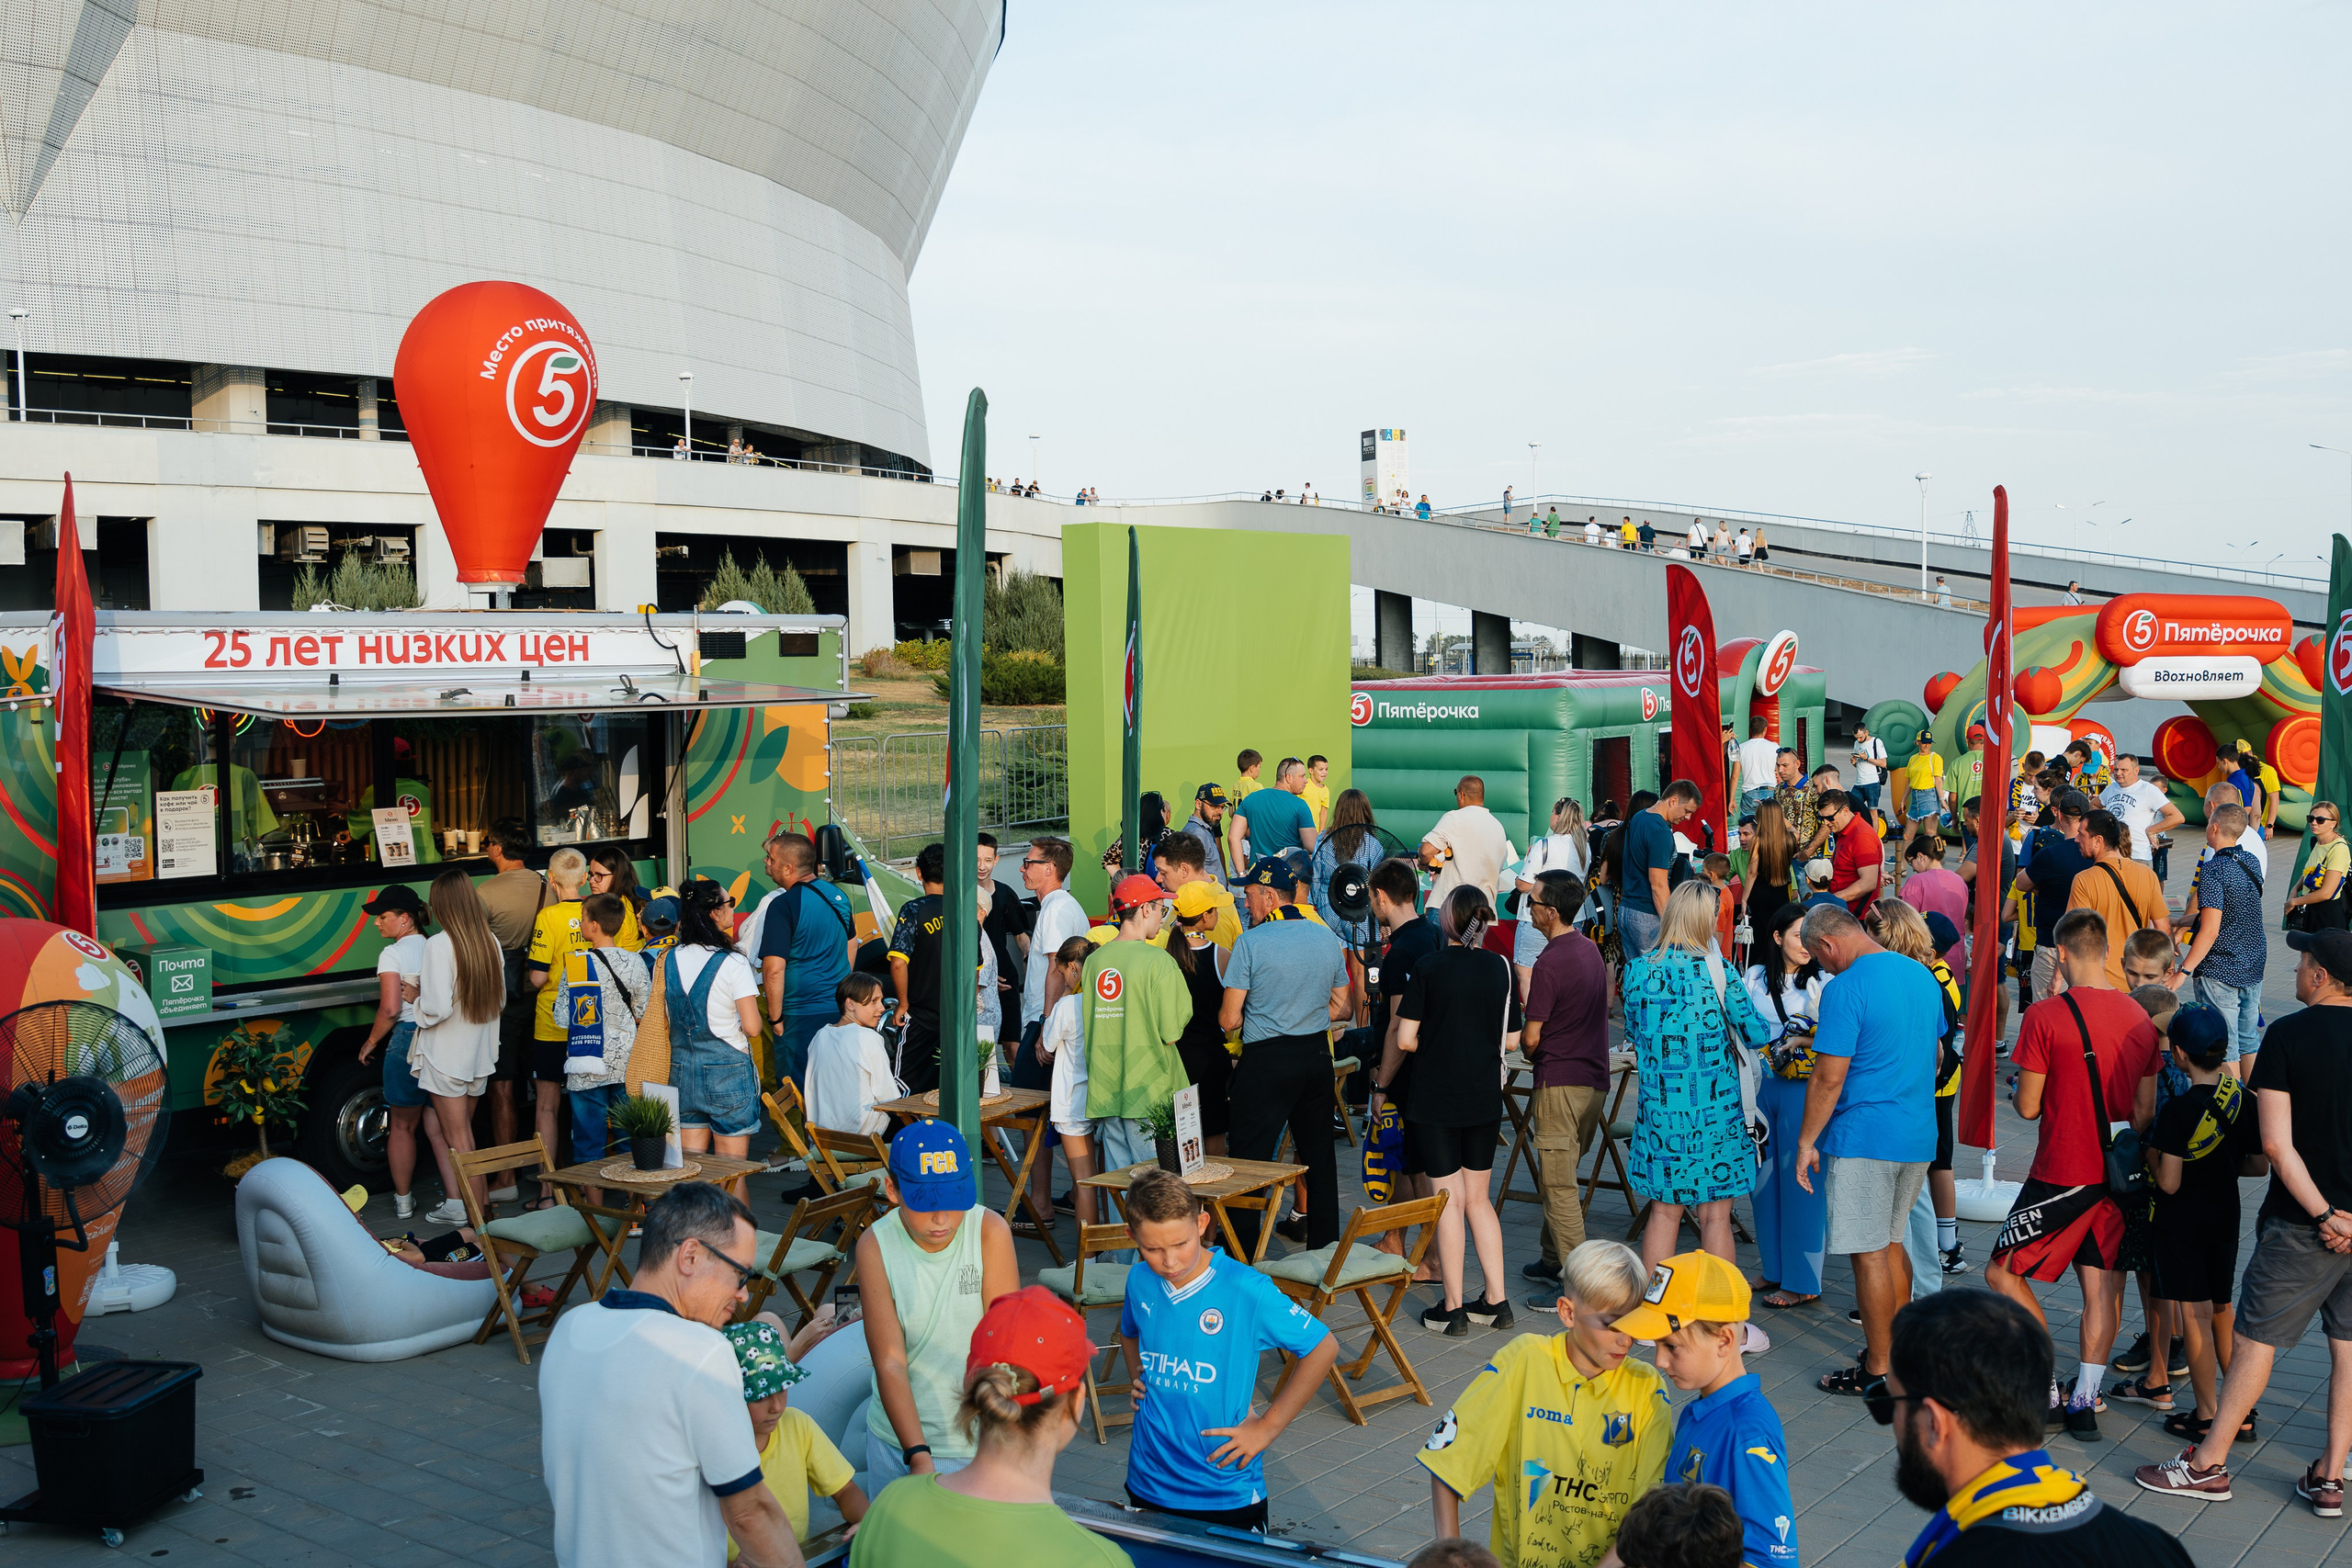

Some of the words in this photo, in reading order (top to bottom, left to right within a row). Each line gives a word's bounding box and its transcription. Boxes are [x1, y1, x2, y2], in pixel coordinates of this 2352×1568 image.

[480, 325, 524, 380] Место
[532, 351, 582, 428] 5
[2133, 614, 2154, 645] 5
[2164, 623, 2282, 646] Пятёрочка
[204, 629, 253, 669] 25
[265, 635, 344, 668] лет
[358, 634, 507, 665] низких
[519, 634, 589, 667] цен
[1770, 641, 1796, 685] 5
[2154, 670, 2245, 682] Вдохновляет
[1378, 702, 1479, 723] Пятёрочка
[159, 958, 205, 973] Почта
[160, 1002, 208, 1015] объединяет
[163, 996, 205, 1007] Пятёрочка
[920, 1150, 959, 1176] FCR
[2003, 1208, 2042, 1231] REEN
[1998, 1224, 2042, 1248] HILL
[958, 1263, 980, 1283] NYC
[1148, 1374, 1199, 1393] IRWAYS
[2003, 1490, 2095, 1524] BIKKEMBER
